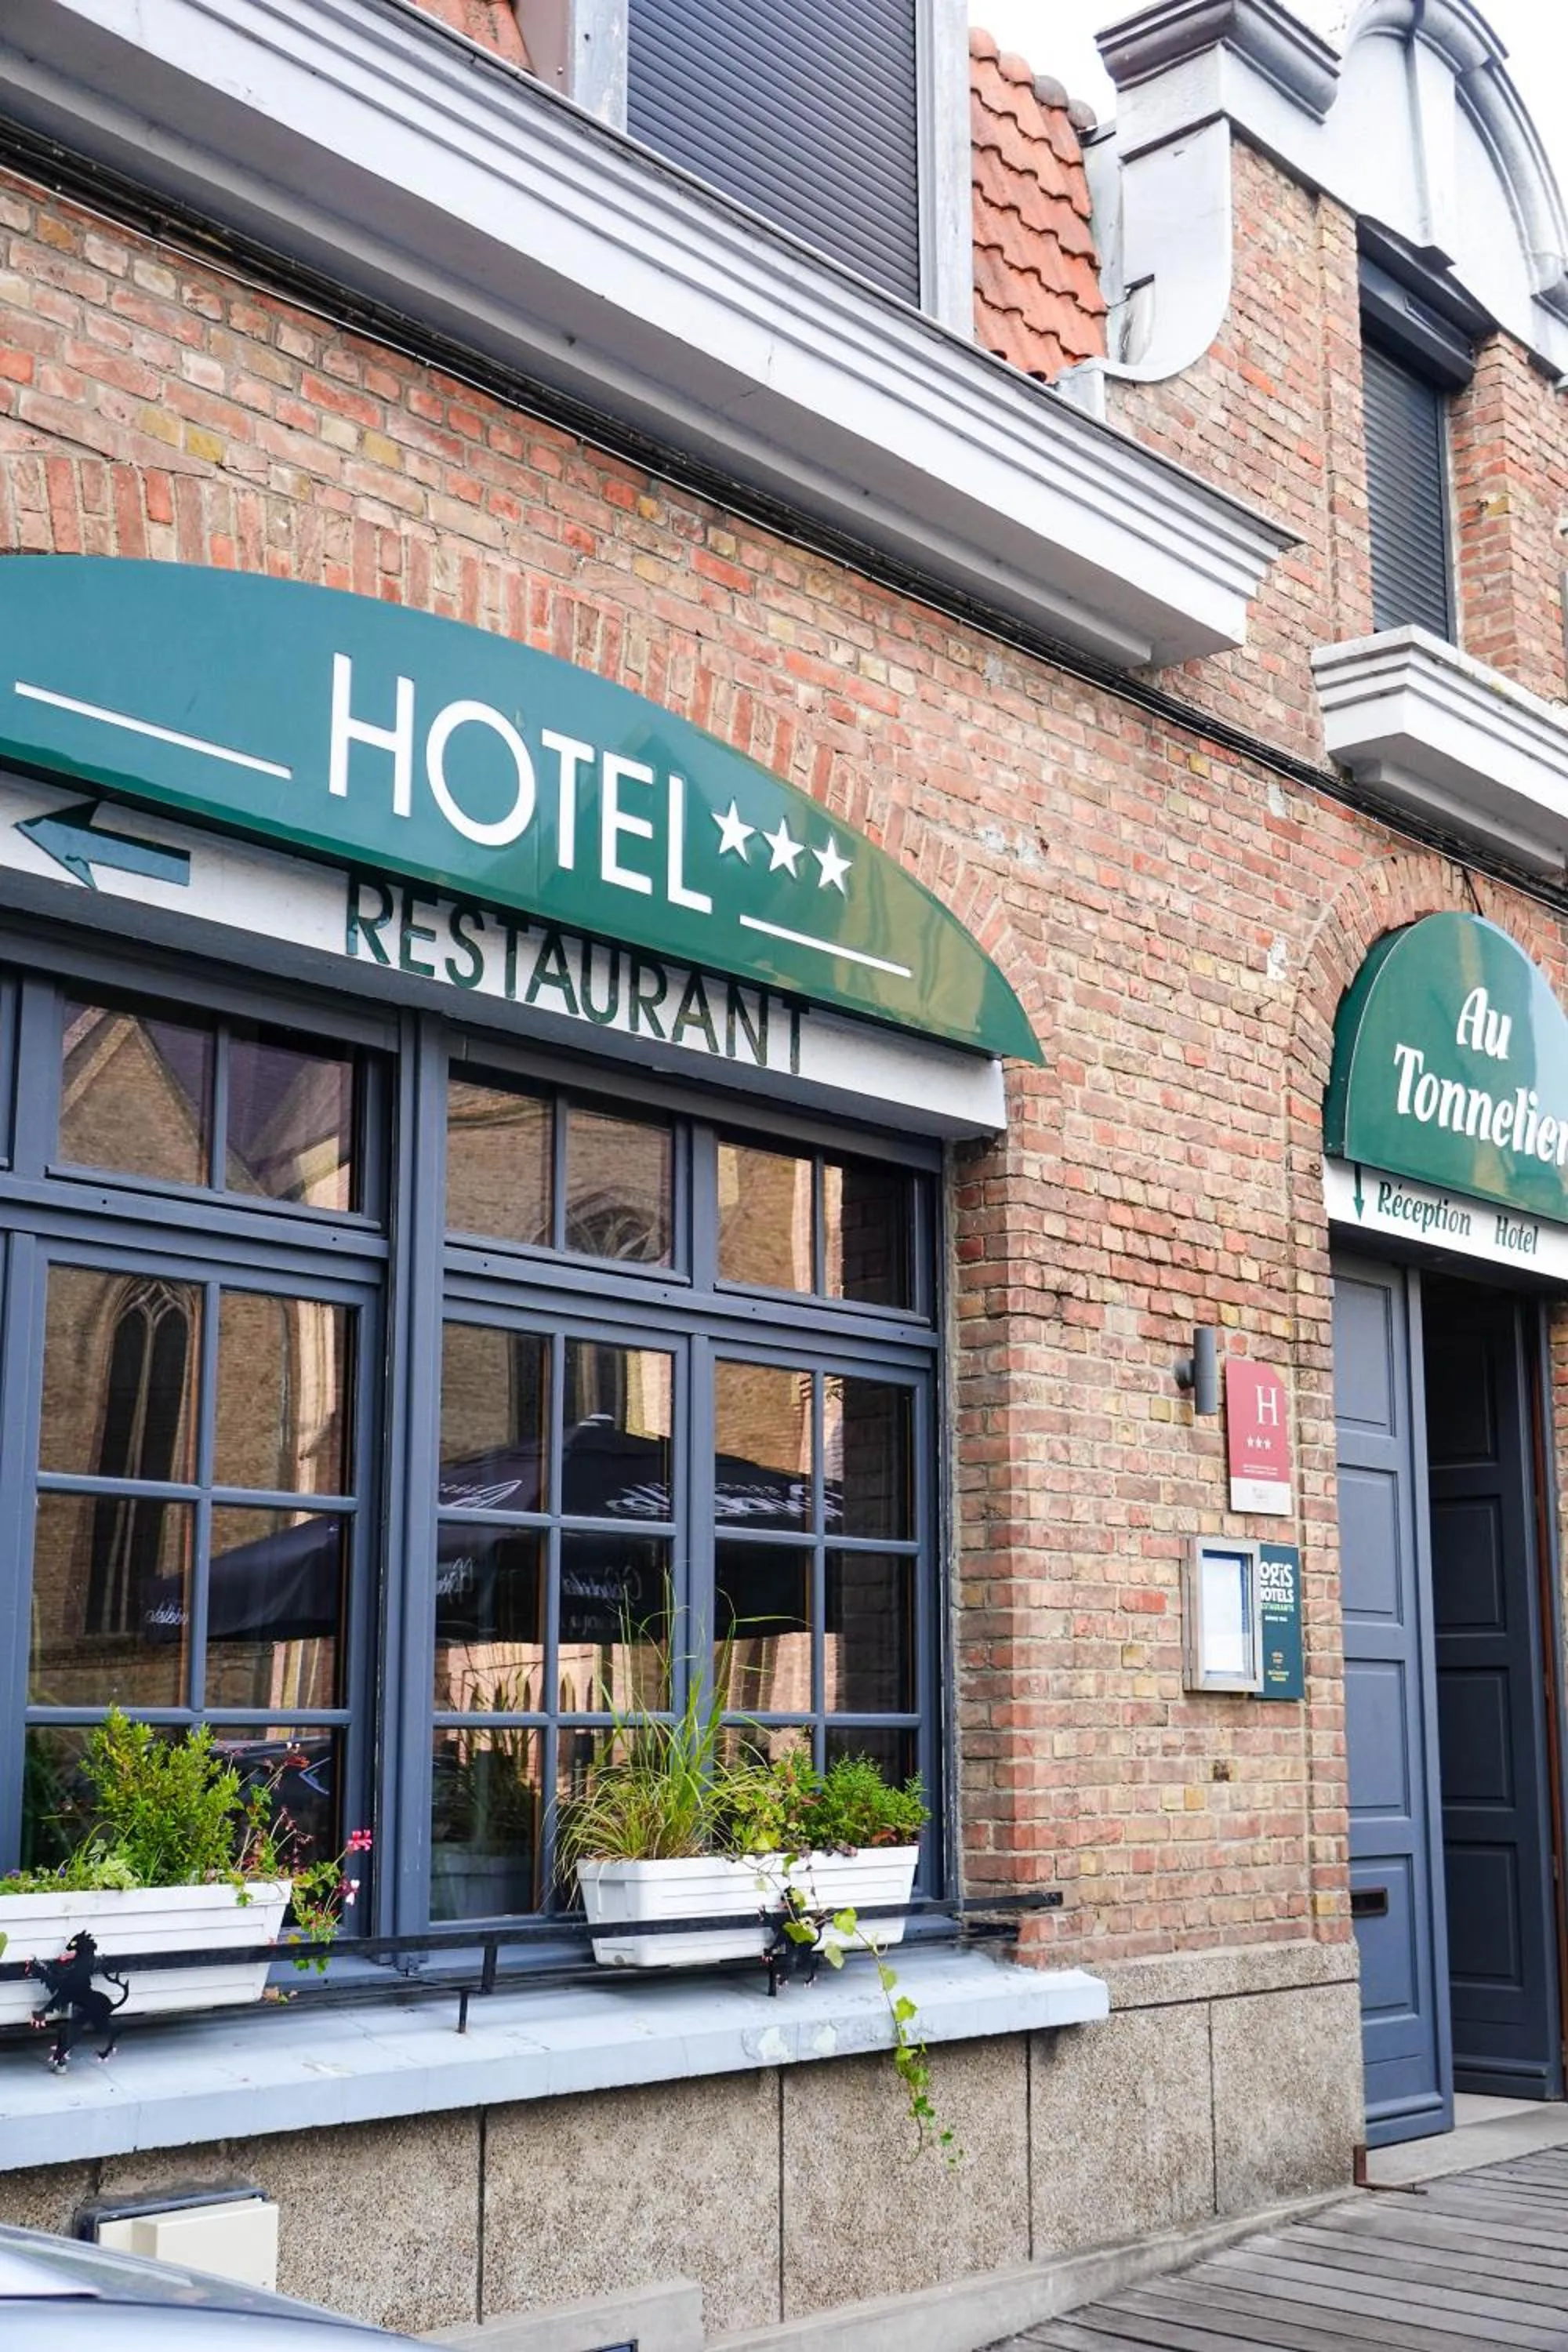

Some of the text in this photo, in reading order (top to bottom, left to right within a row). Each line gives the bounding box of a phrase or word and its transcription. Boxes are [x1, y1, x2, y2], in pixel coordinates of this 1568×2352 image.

[328, 652, 713, 914] HOTEL
[345, 872, 810, 1075] RESTAURANT
[1456, 986, 1512, 1060] Au
[1393, 1043, 1568, 1167] Tonnelier
[1377, 1181, 1538, 1256] Réception Hotel
[1255, 1385, 1279, 1426] H
